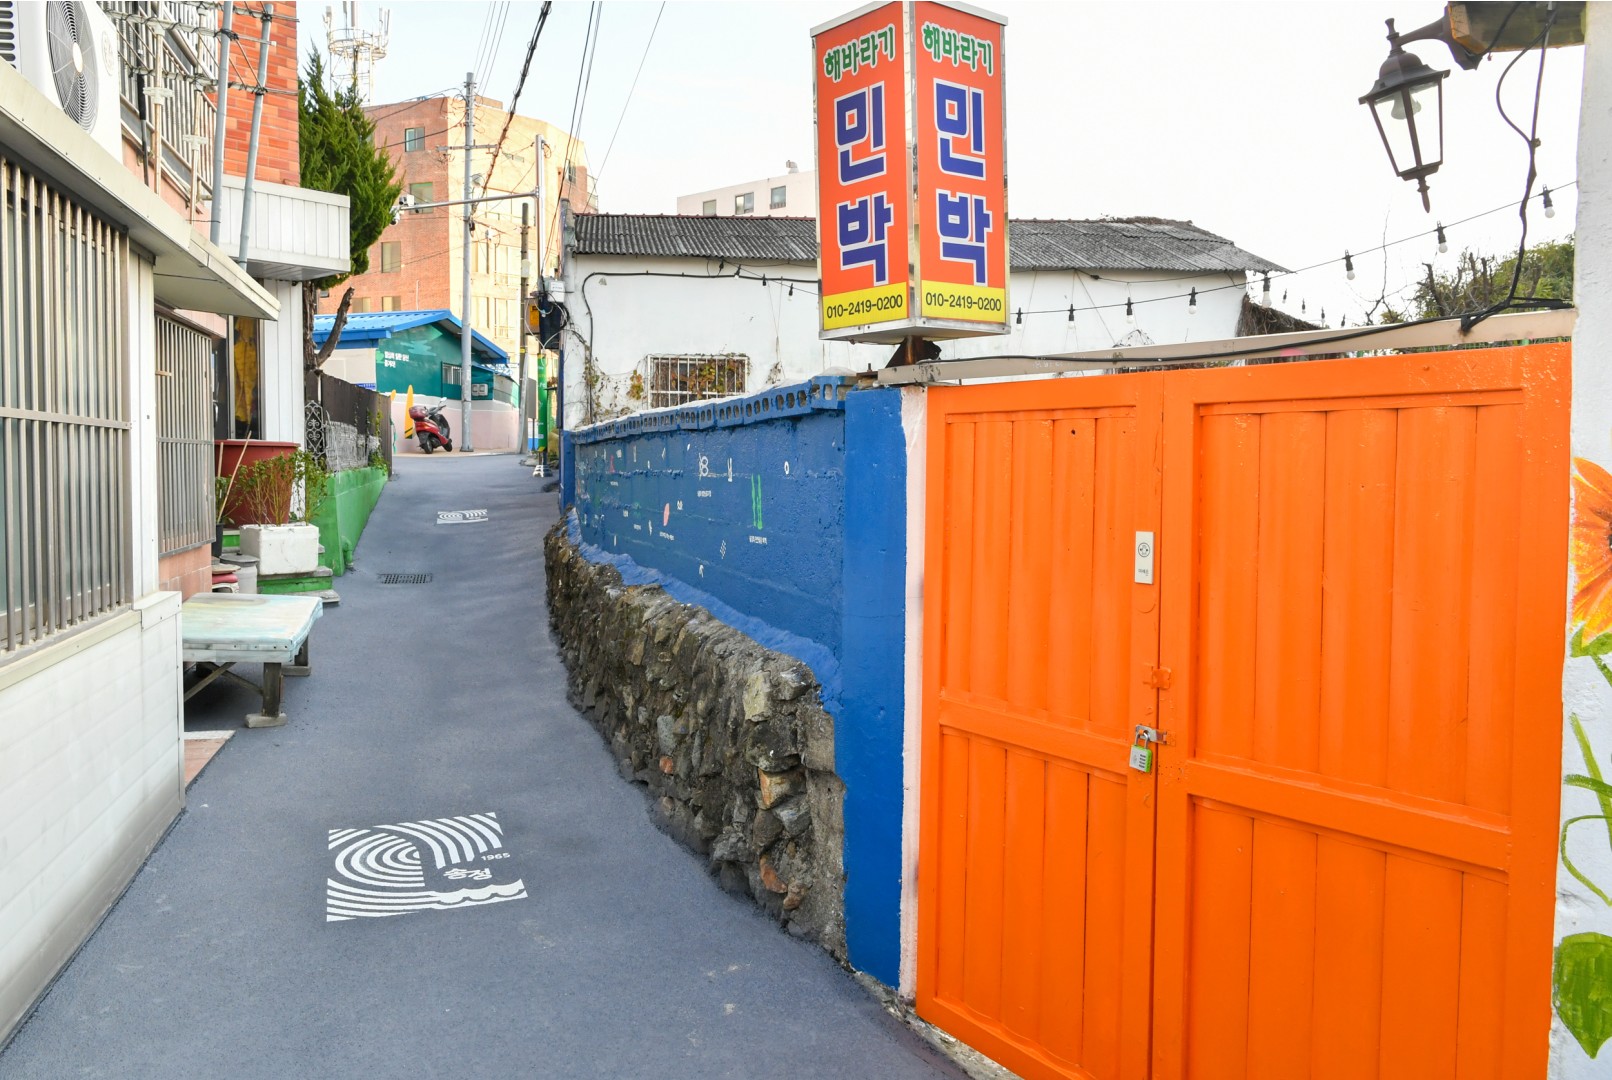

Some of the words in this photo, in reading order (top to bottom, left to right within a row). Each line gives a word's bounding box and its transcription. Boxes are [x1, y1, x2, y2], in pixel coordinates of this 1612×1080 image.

[824, 24, 894, 81] 해바라기
[923, 23, 992, 75] 해바라기
[835, 82, 893, 285] 민박
[934, 79, 992, 286] 민박
[826, 294, 903, 319] 010-2419-0200
[925, 291, 1002, 312] 010-2419-0200
[443, 868, 493, 880] 송정
[481, 852, 511, 861] 1965
